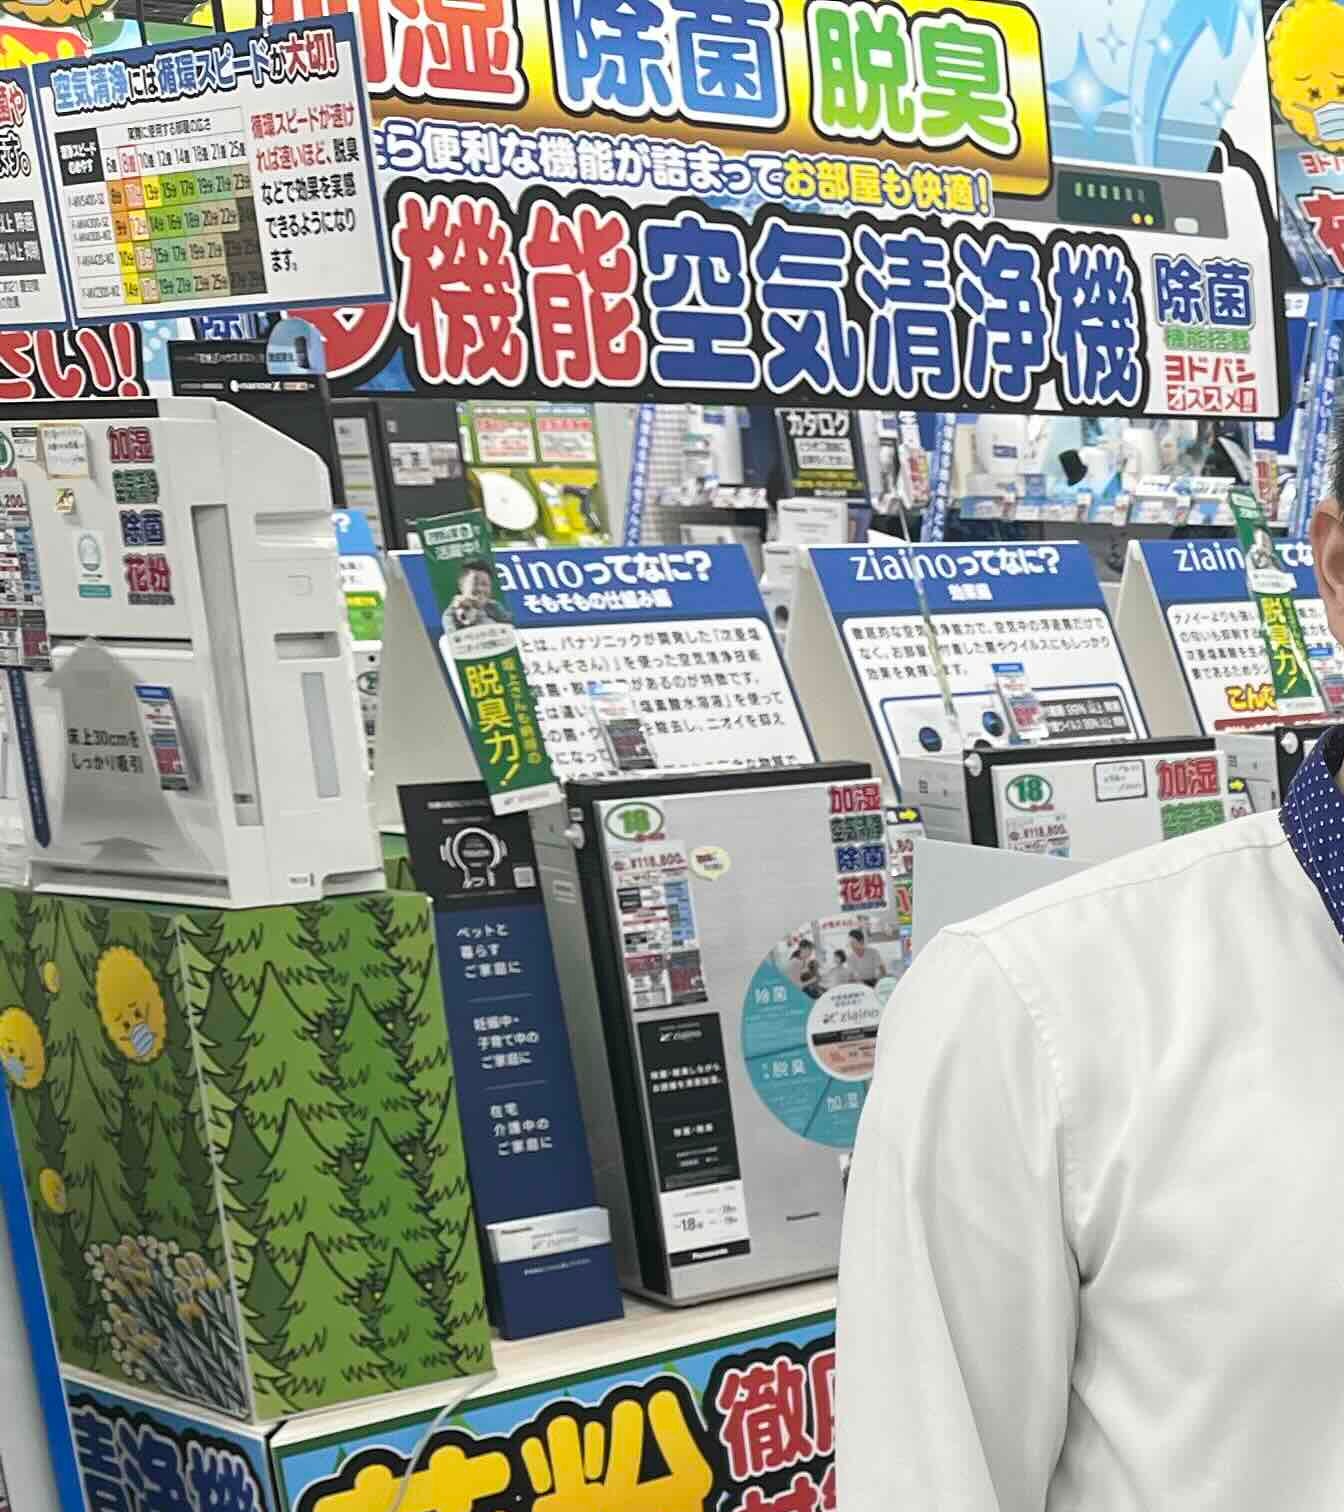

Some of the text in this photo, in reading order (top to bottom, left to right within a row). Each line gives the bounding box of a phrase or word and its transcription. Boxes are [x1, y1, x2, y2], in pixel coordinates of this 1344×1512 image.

[562, 0, 1013, 148] 除菌 脱臭
[266, 208, 354, 238] できるようになり
[271, 249, 298, 272] ます。
[1155, 256, 1252, 326] 除菌
[1165, 355, 1255, 382] ヨドバシ
[1156, 758, 1218, 799] 加湿
